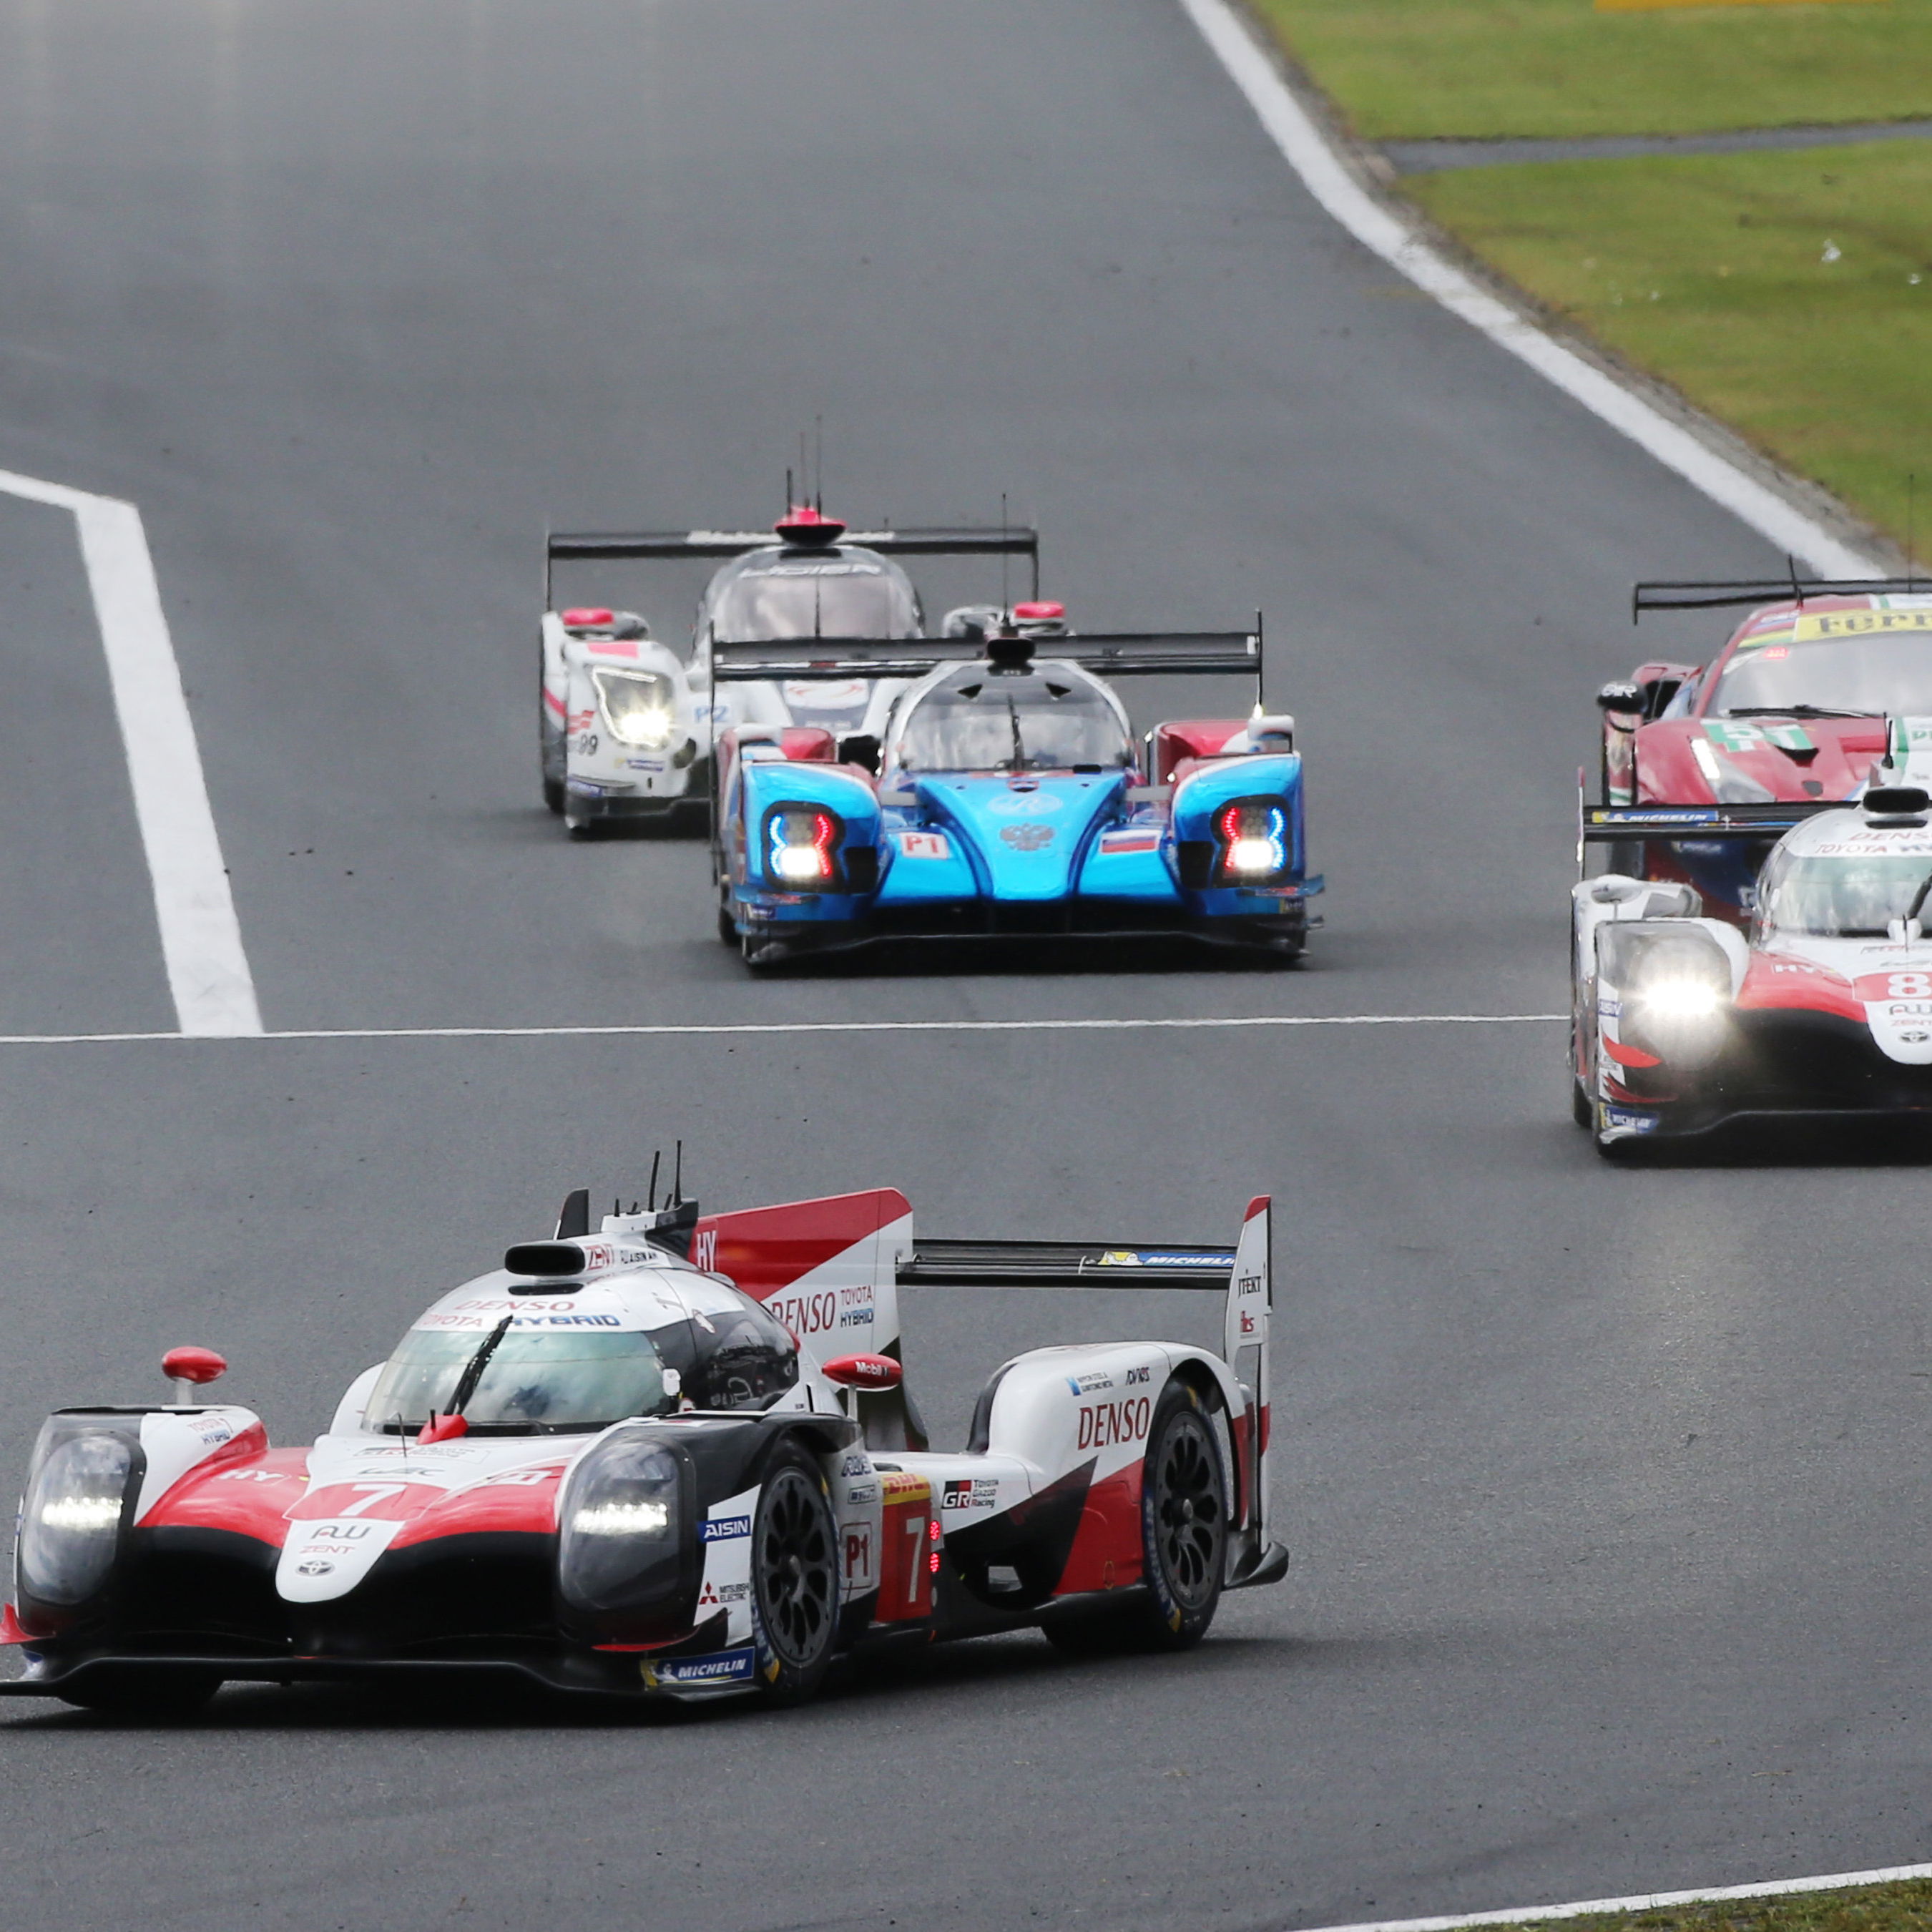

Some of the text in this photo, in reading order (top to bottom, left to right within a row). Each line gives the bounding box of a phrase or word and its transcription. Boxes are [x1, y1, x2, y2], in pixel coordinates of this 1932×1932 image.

[905, 835, 939, 853] P1
[1815, 843, 1888, 854] TOYOTA
[1887, 973, 1932, 998] 8
[697, 1230, 716, 1272] HY
[454, 1300, 575, 1311] DENSO
[840, 1285, 873, 1306] TOYOTA
[513, 1314, 621, 1326] HYBRID
[772, 1291, 835, 1335] DENSO
[840, 1307, 874, 1328] HYBRID
[855, 1360, 883, 1376] Mobil
[1078, 1396, 1150, 1451] DENSO
[338, 1484, 408, 1517] 7
[943, 1491, 971, 1508] GR
[704, 1519, 748, 1539] AISIN
[300, 1545, 355, 1555] ZENT
[846, 1534, 868, 1579] P1
[906, 1516, 926, 1603] 7
[678, 1659, 746, 1678] MICHELIN
